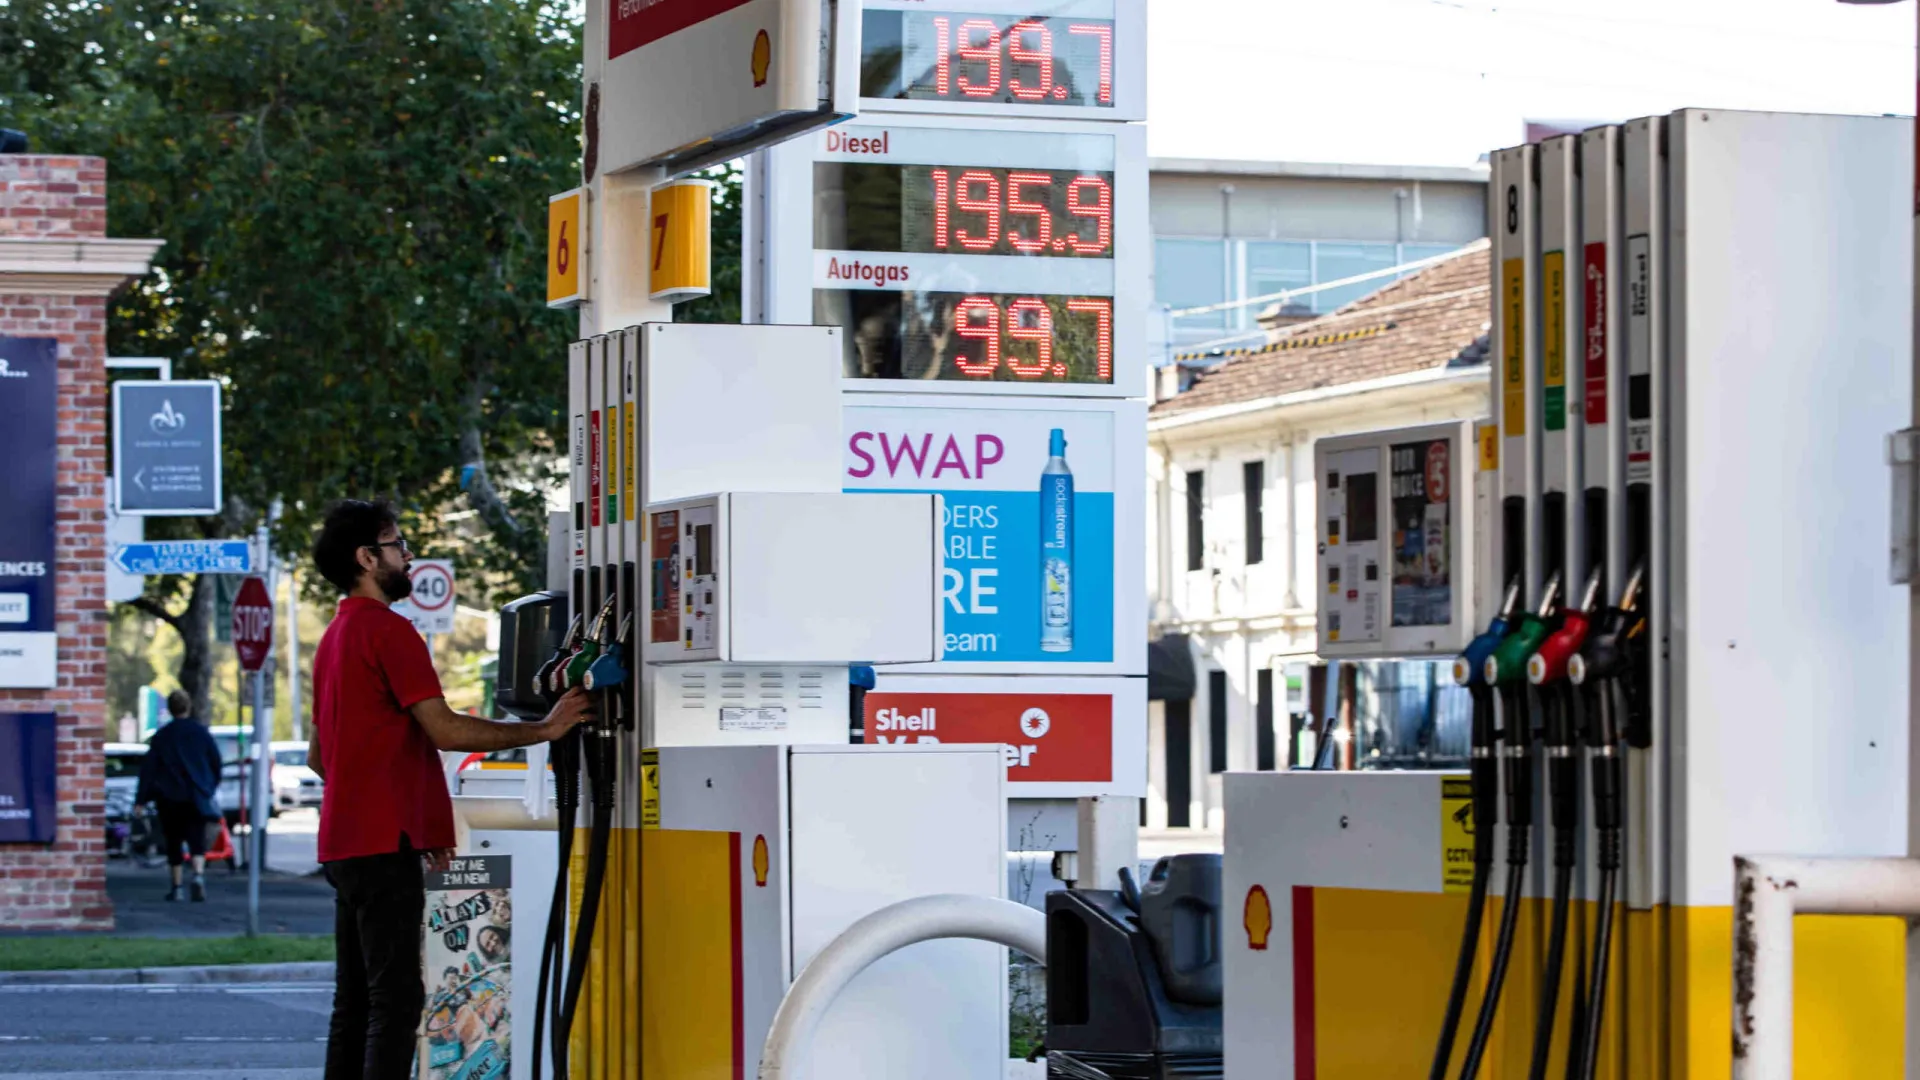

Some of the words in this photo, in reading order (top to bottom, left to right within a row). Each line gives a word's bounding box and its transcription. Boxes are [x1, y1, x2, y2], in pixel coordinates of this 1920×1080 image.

[933, 17, 1112, 103] 199.7
[826, 130, 889, 154] Diesel
[932, 170, 1111, 253] 195.9
[1508, 184, 1518, 234] 8
[557, 220, 569, 275] 6
[654, 212, 669, 271] 7
[827, 257, 909, 287] Autogas
[955, 296, 1111, 379] 99.7
[847, 431, 1005, 480] SWAP
[1055, 477, 1068, 548] sodastream
[944, 535, 997, 559] BLE
[415, 576, 447, 598] 40
[233, 606, 271, 641] STOP
[875, 708, 937, 731] Shell
[468, 859, 486, 871] ME
[431, 893, 488, 931] ALWAYS
